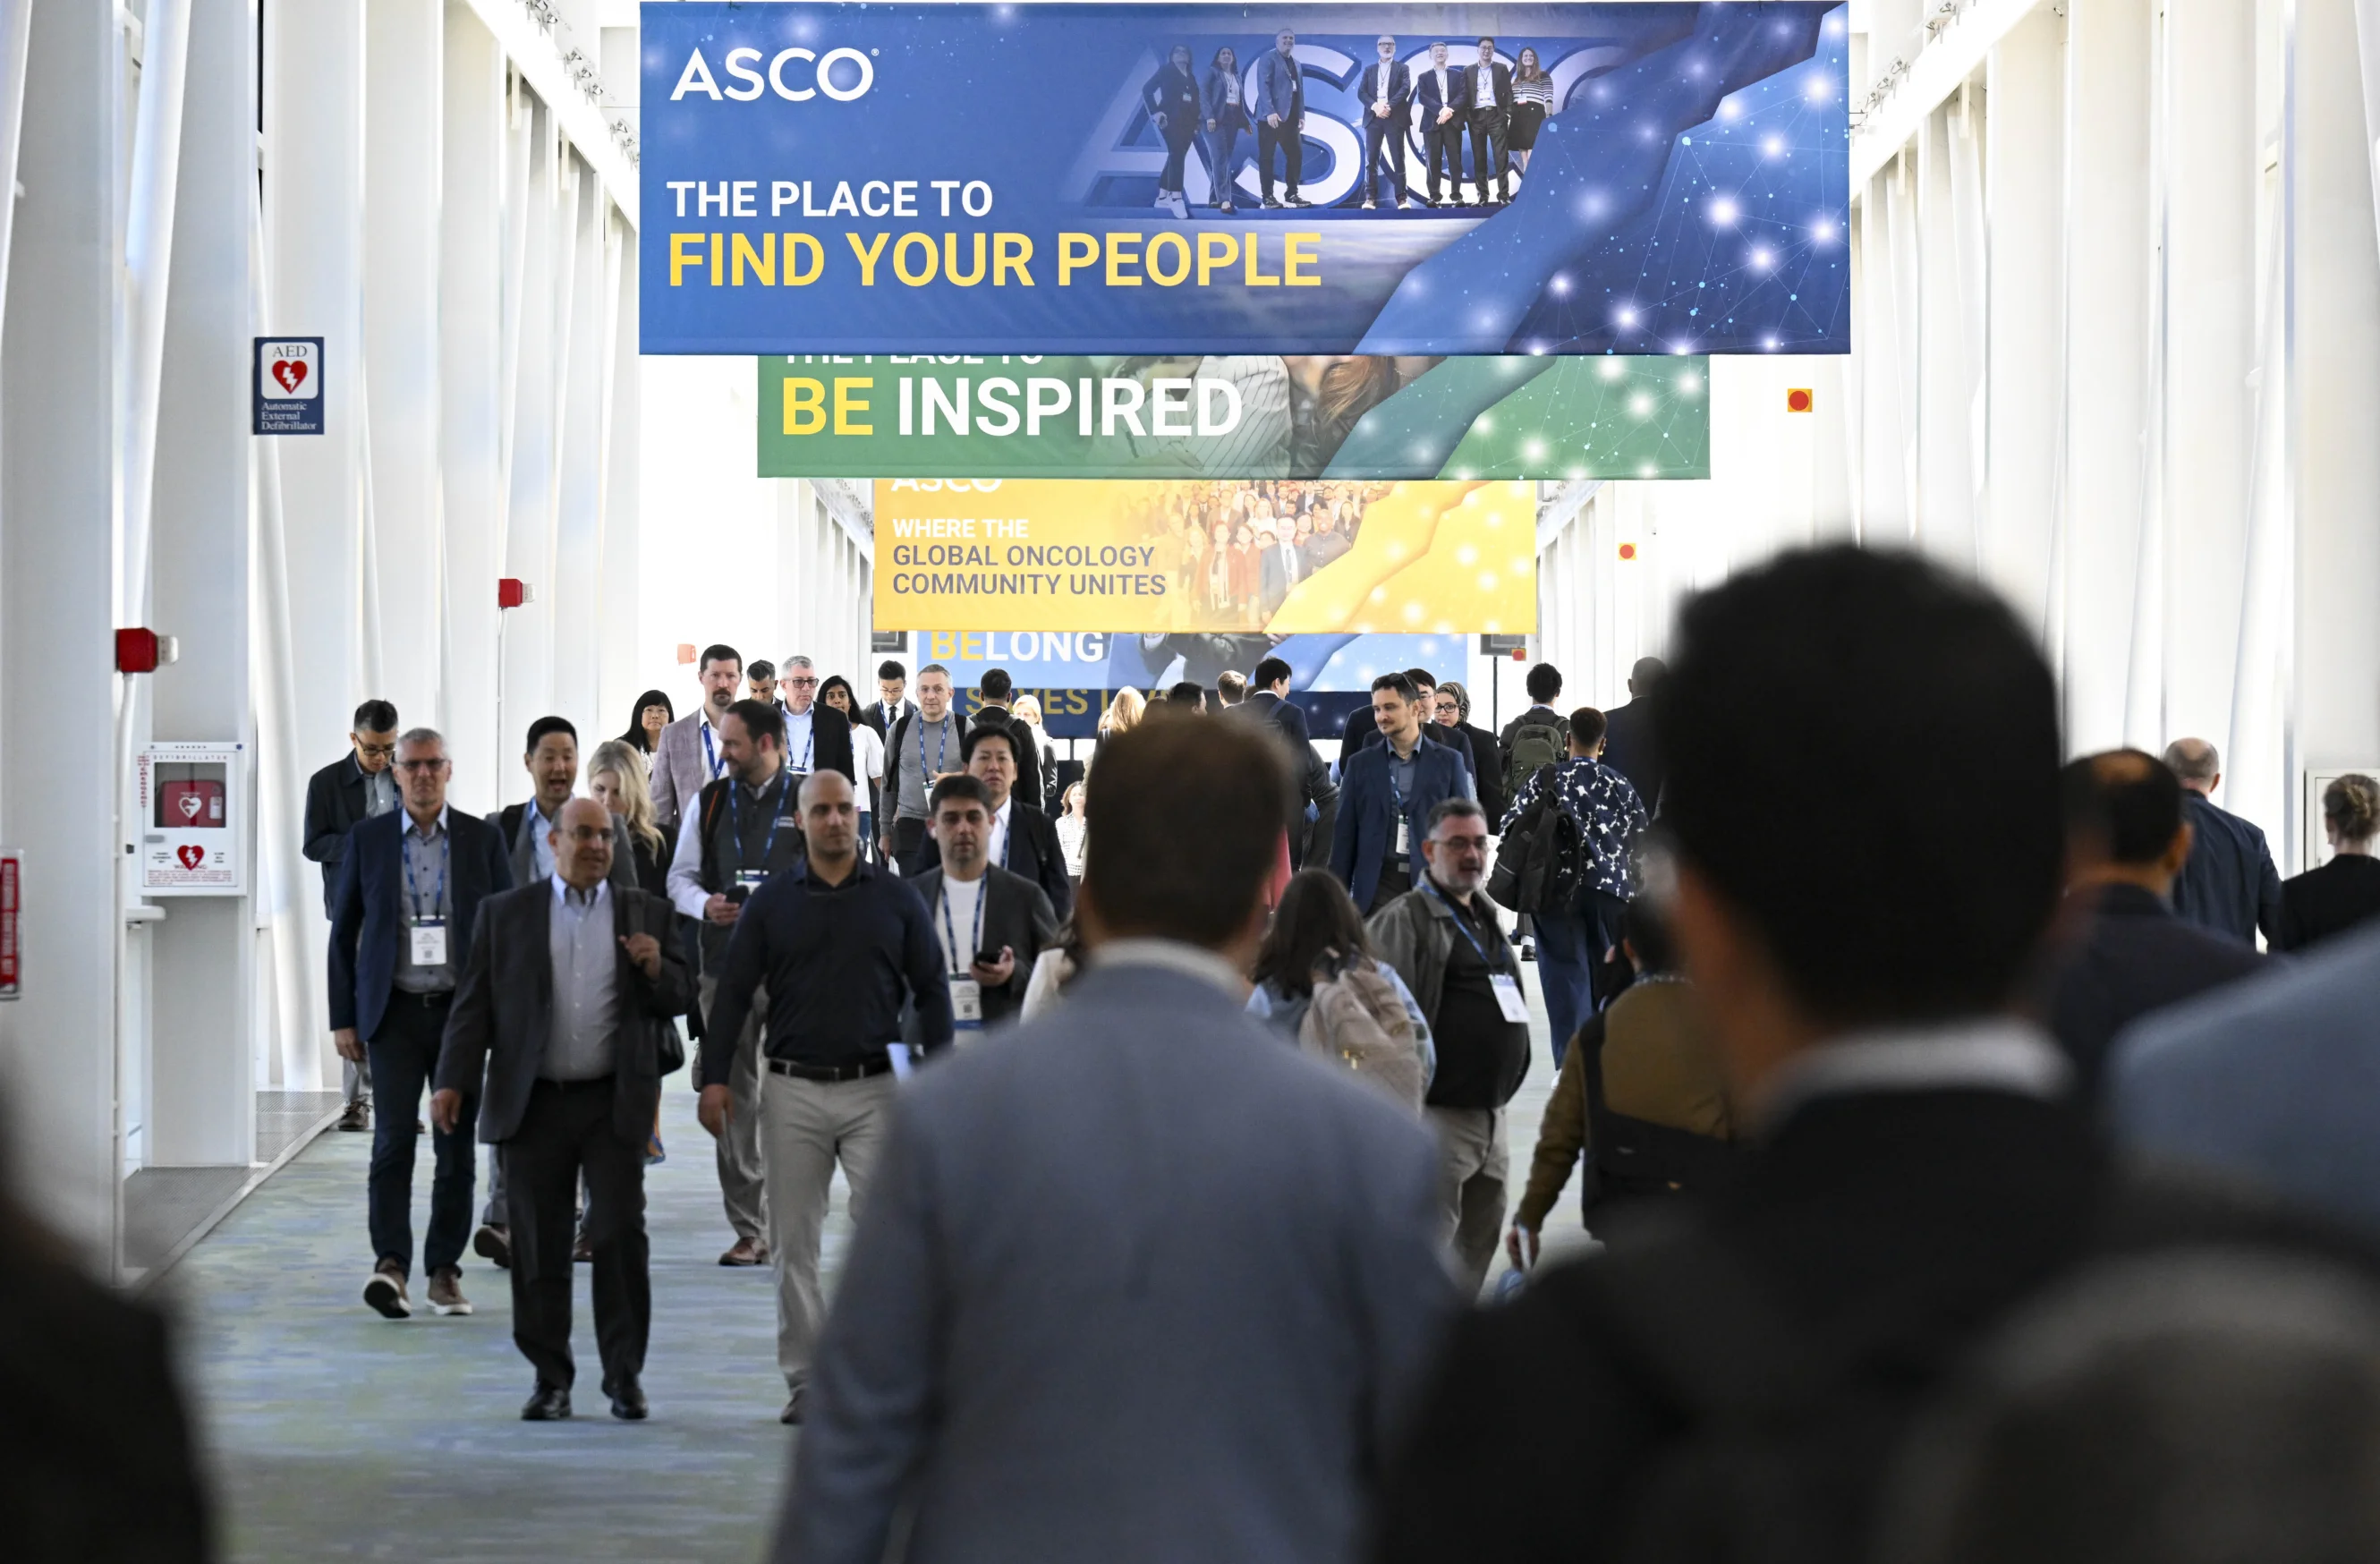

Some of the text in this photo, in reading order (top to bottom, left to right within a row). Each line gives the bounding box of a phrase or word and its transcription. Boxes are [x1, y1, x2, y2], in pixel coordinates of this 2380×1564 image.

[667, 181, 993, 217] THE PLACE TO
[669, 233, 1322, 286] FIND YOUR PEOPLE
[272, 345, 307, 357] AED
[261, 401, 307, 411] Automatic
[261, 412, 300, 421] External
[783, 377, 1243, 436] BE INSPIRED
[261, 421, 317, 430] Defibrillator
[893, 518, 1029, 539] WHERE THE
[894, 544, 1155, 567] GLOBAL ONCOLOGY
[893, 573, 1167, 596] COMMUNITY UNITES
[931, 632, 1104, 662] BELONG
